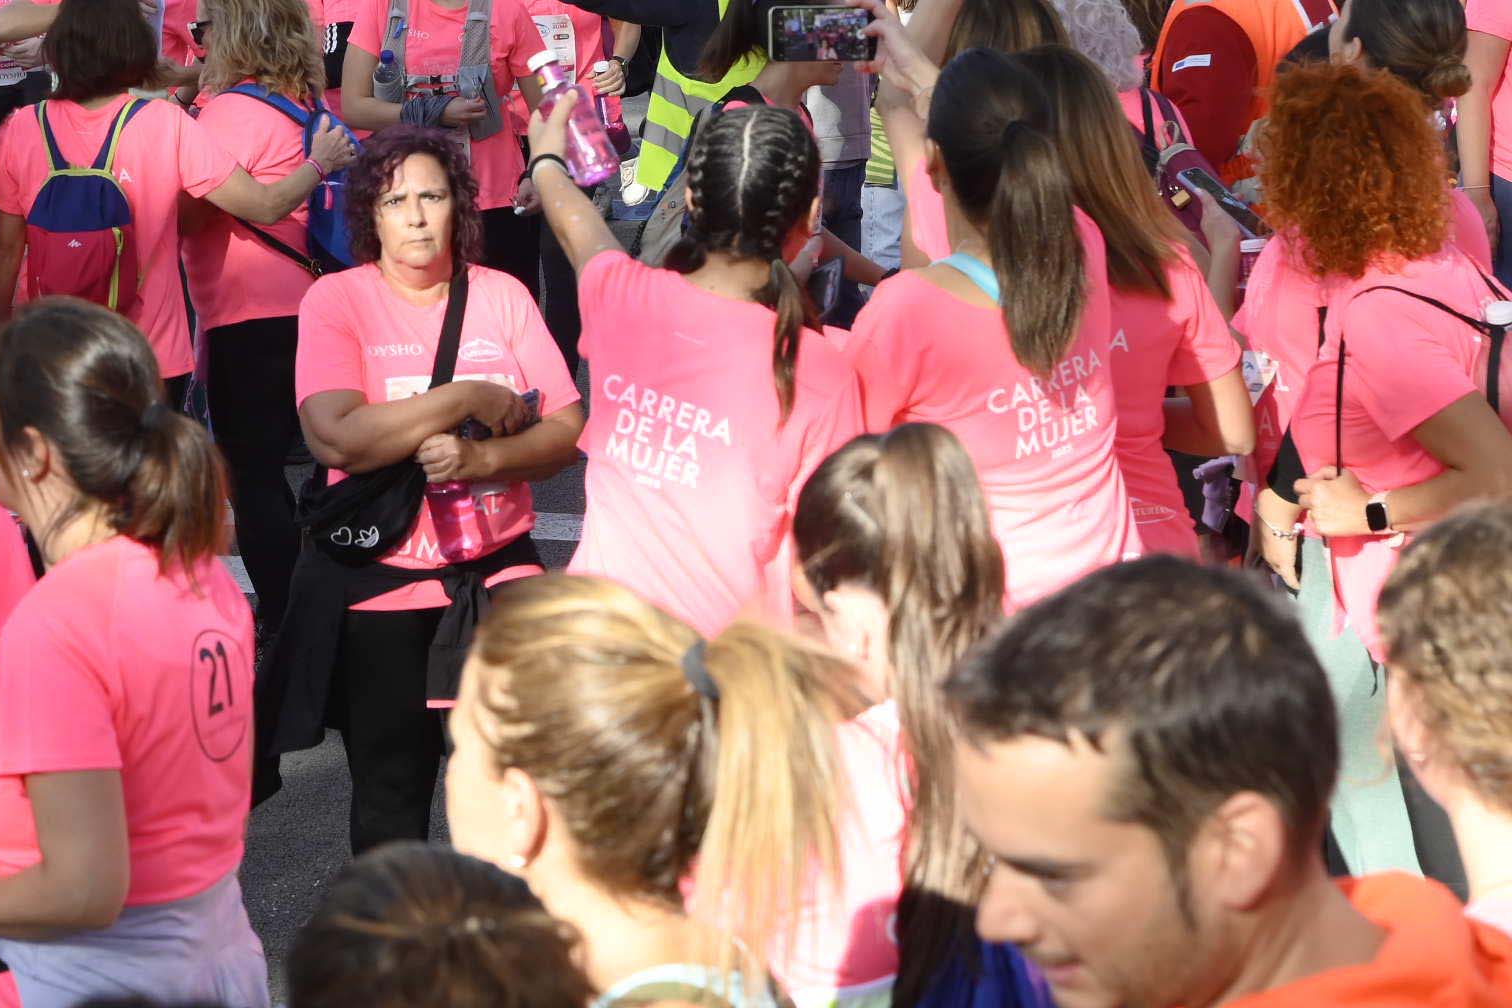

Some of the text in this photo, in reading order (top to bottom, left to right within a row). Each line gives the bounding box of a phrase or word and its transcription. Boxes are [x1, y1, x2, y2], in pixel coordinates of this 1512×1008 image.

[603, 374, 732, 446] CARRERA
[988, 349, 1103, 414] CARRERA
[1018, 383, 1092, 433] DE LA
[606, 432, 700, 489] MUJER
[615, 408, 698, 461] DE LA
[1016, 405, 1099, 460] MUJER
[199, 640, 234, 717] 21
